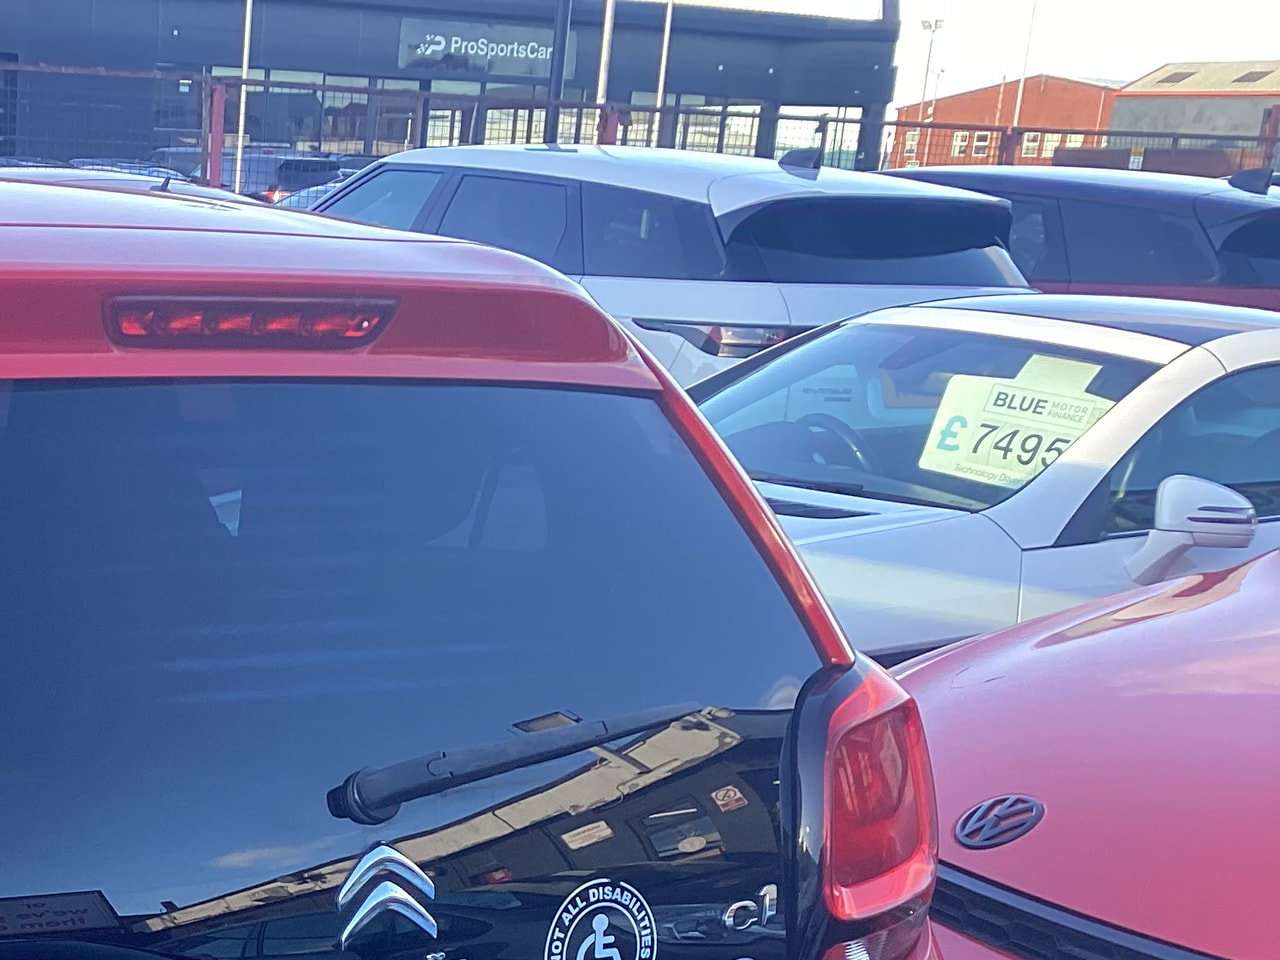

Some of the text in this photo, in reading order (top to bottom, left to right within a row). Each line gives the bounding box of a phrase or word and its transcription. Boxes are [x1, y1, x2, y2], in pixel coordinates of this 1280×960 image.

[992, 391, 1089, 416] BLUE MOTOR
[1047, 409, 1084, 424] FINANCE
[561, 896, 587, 926] ALL
[588, 886, 652, 959] DISABILITIES
